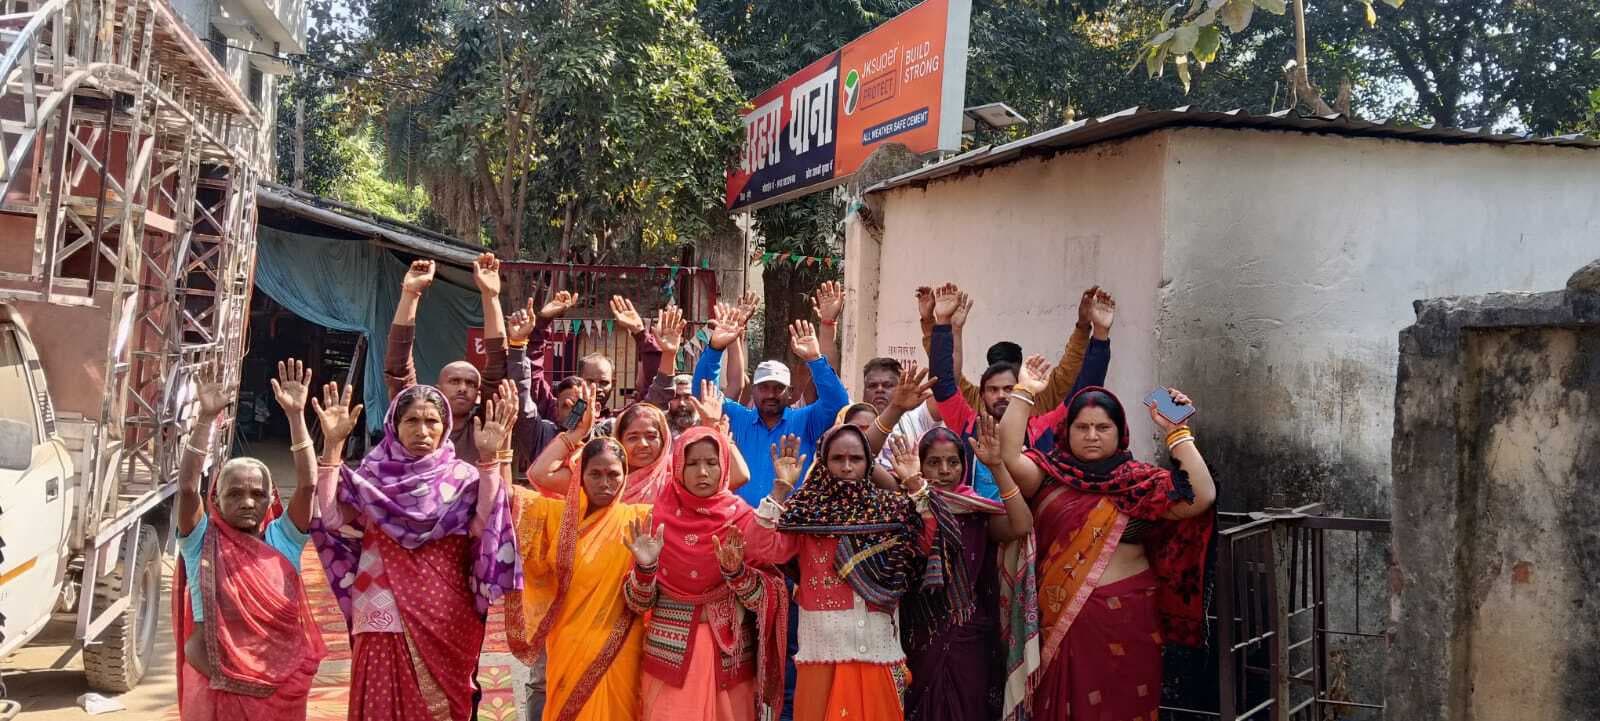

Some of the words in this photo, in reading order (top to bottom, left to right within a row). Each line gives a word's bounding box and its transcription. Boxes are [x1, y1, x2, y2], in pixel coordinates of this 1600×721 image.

[905, 41, 930, 65] BUILD
[904, 55, 939, 84] STRONG
[863, 78, 893, 100] PROTECT
[789, 65, 838, 156] थाना
[871, 123, 894, 139] WEATHER
[894, 118, 907, 132] SAFE
[907, 110, 929, 128] CEMENT
